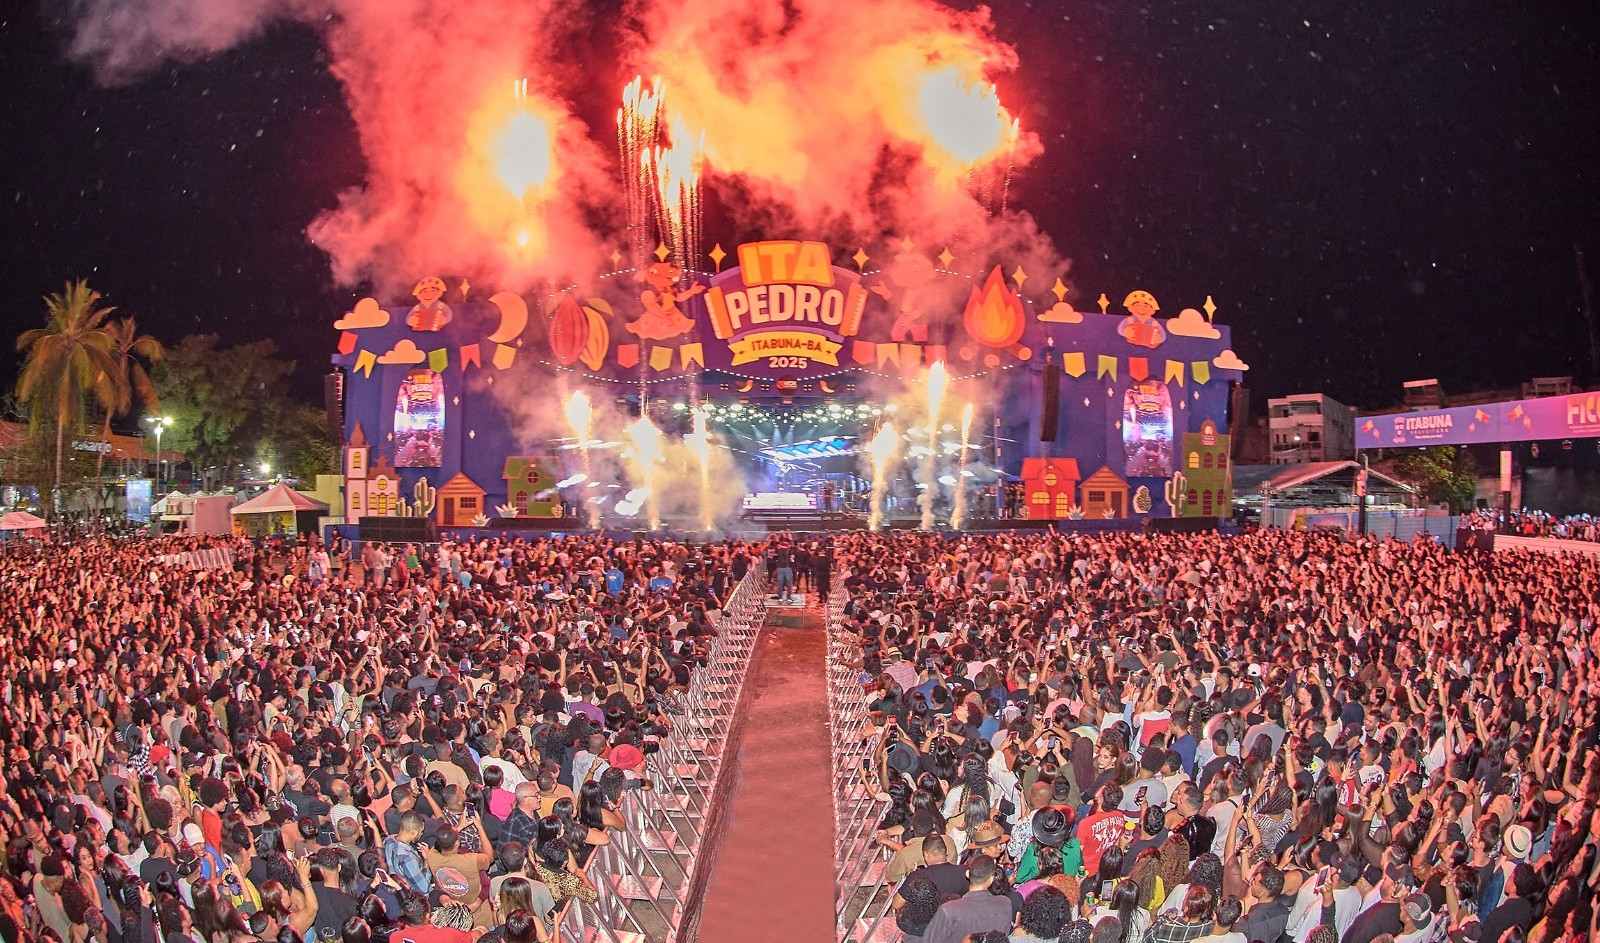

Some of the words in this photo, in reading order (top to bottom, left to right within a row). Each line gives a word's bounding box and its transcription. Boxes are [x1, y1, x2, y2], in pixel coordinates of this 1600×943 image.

[741, 242, 829, 284] ITA
[725, 284, 844, 329] PEDRO
[751, 338, 822, 351] ITABUNA-BA
[768, 356, 808, 369] 2025
[1567, 396, 1600, 425] FIC
[1406, 414, 1452, 430] ITABUNA
